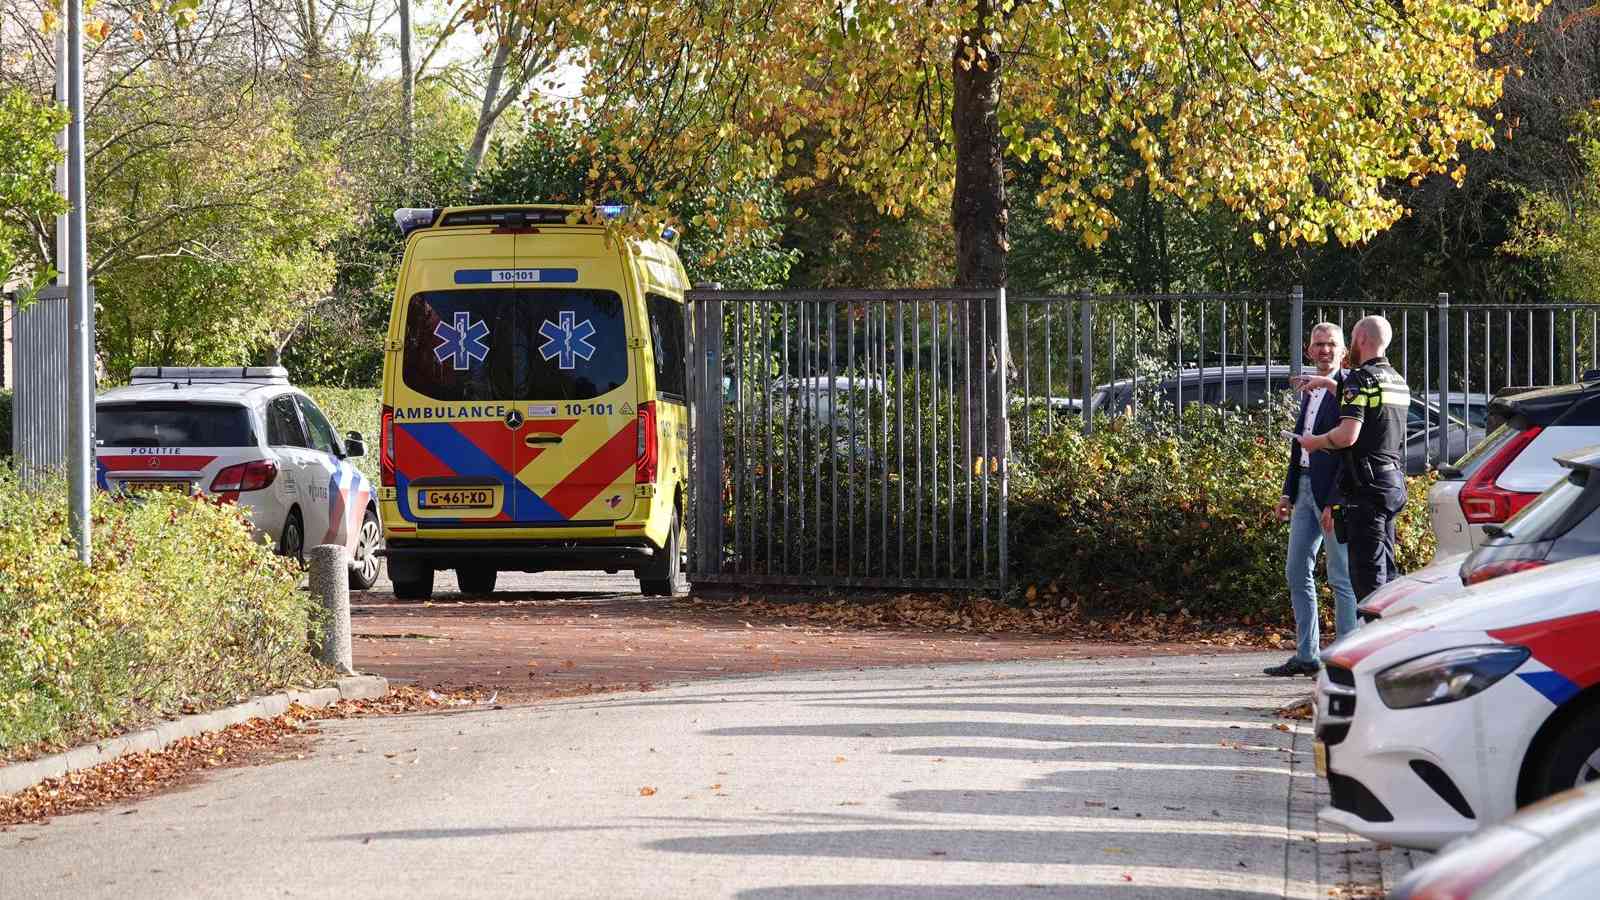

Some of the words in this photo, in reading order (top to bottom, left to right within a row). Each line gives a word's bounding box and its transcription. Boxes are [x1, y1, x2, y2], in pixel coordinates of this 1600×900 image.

[499, 271, 533, 281] 10-101
[395, 405, 505, 419] AMBULANCE
[564, 403, 614, 416] 10-101
[130, 447, 182, 455] POLITIE
[430, 491, 487, 504] G-461-XD
